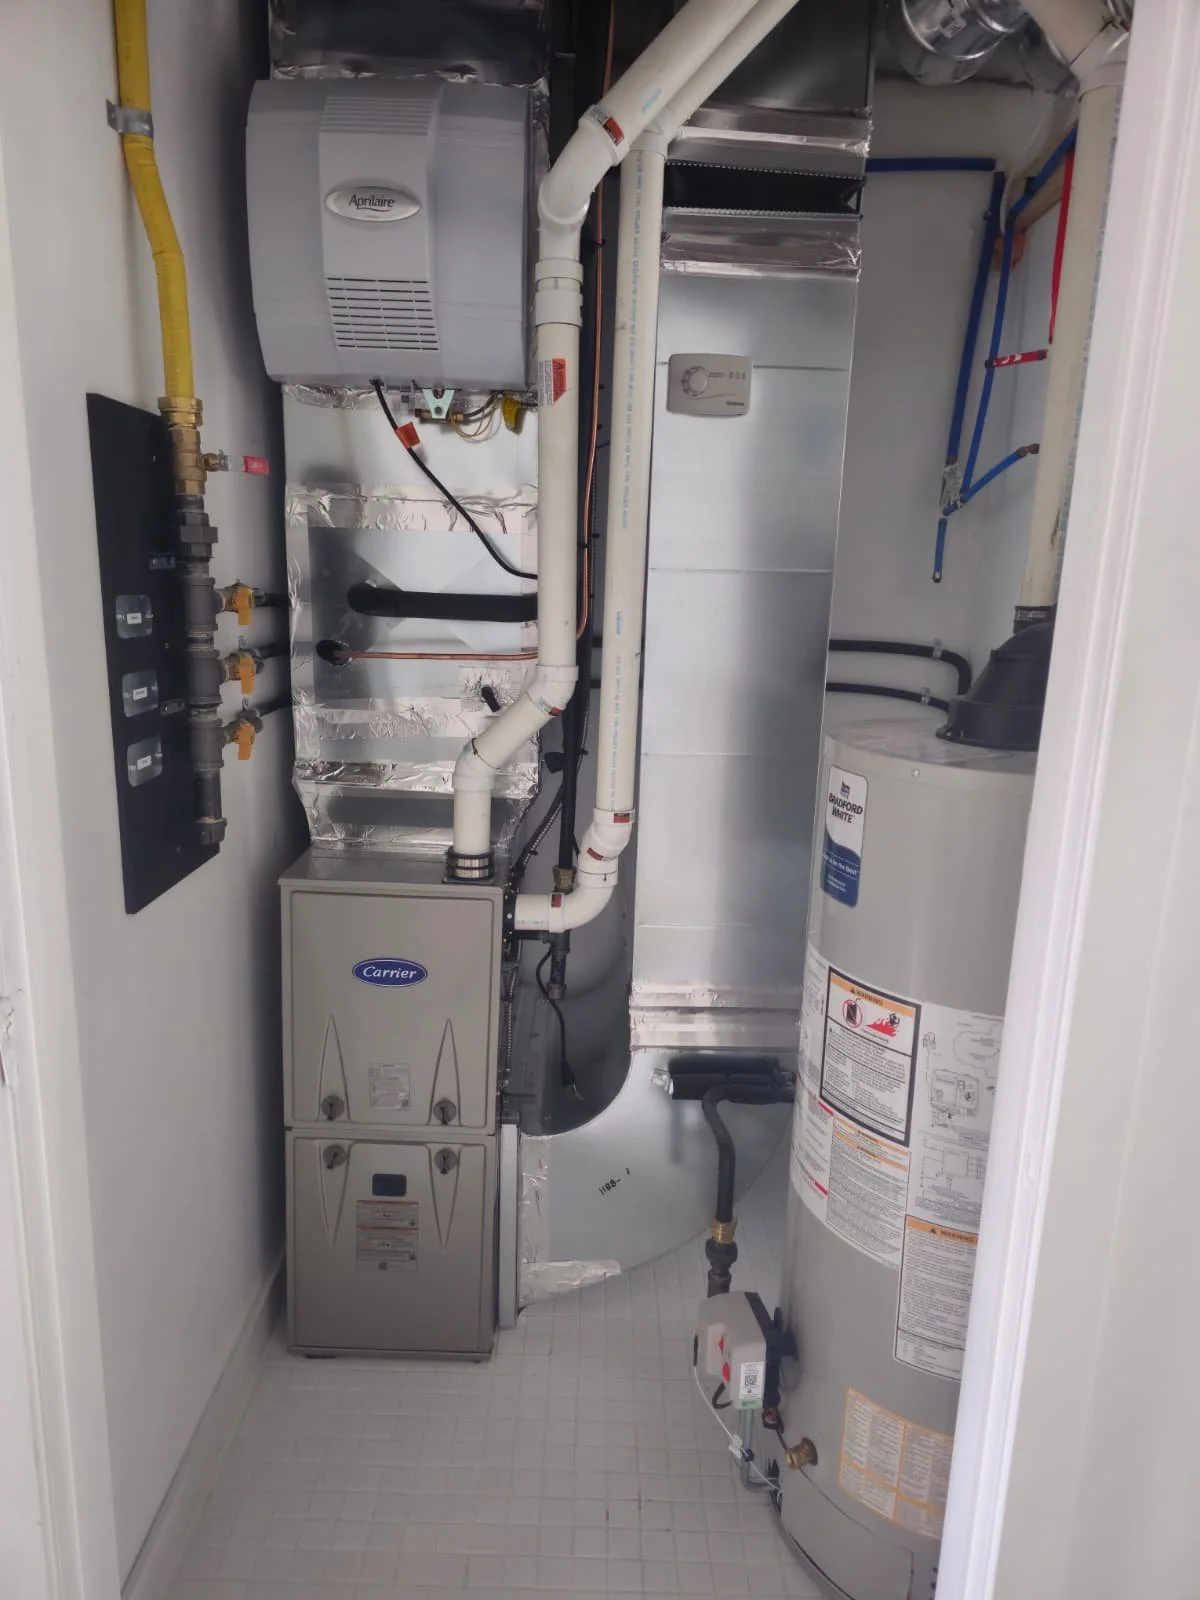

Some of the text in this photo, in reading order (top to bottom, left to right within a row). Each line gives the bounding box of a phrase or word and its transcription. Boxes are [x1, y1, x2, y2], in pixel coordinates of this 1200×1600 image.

[349, 194, 395, 209] Aprilaire
[828, 792, 864, 816] BRADFORD
[831, 806, 853, 824] WHITE
[363, 966, 416, 979] Carrier
